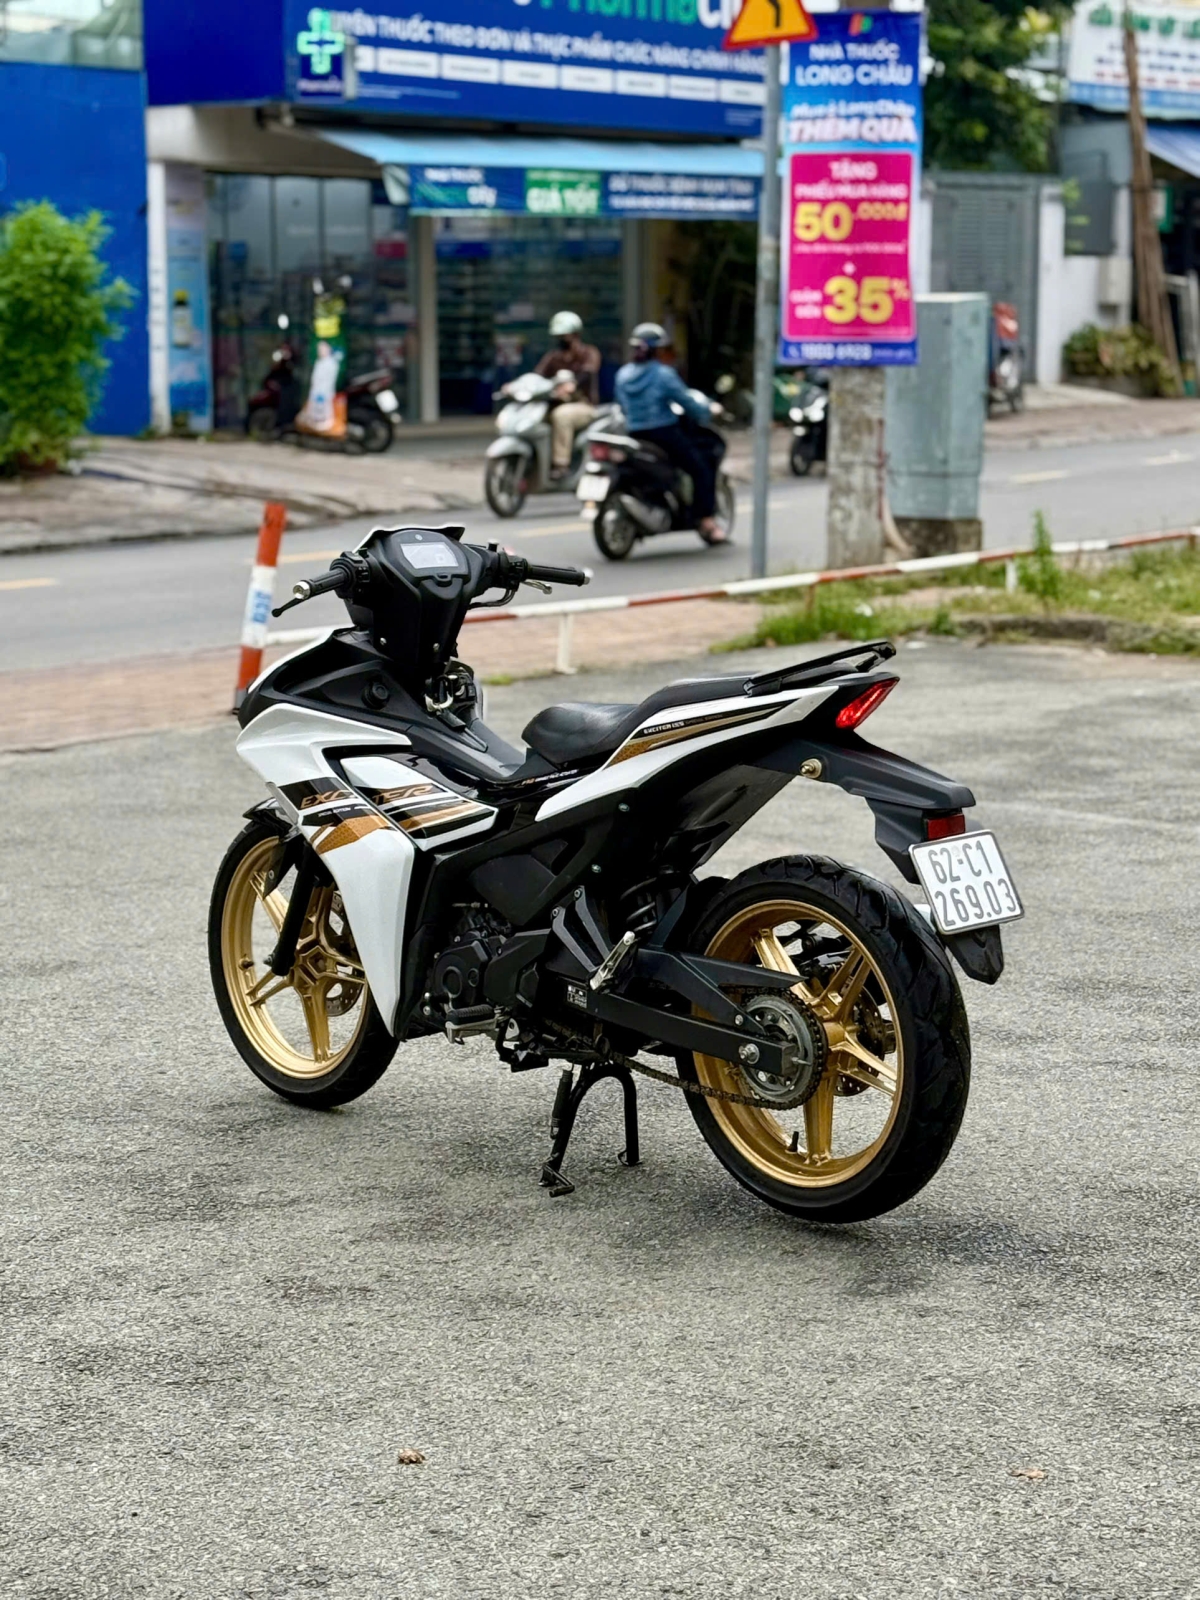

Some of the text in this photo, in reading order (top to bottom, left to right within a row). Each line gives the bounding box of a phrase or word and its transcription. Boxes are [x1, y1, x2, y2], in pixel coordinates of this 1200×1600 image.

[378, 13, 434, 43] THUỐC
[434, 21, 476, 48] THEO
[511, 27, 533, 53] VÀ
[808, 37, 900, 61] NHÀ THUỐC
[795, 60, 913, 86] LONG CHÂU
[789, 114, 860, 142] THÊM
[829, 157, 878, 182] TẶNG
[934, 878, 1016, 927] 269.03
